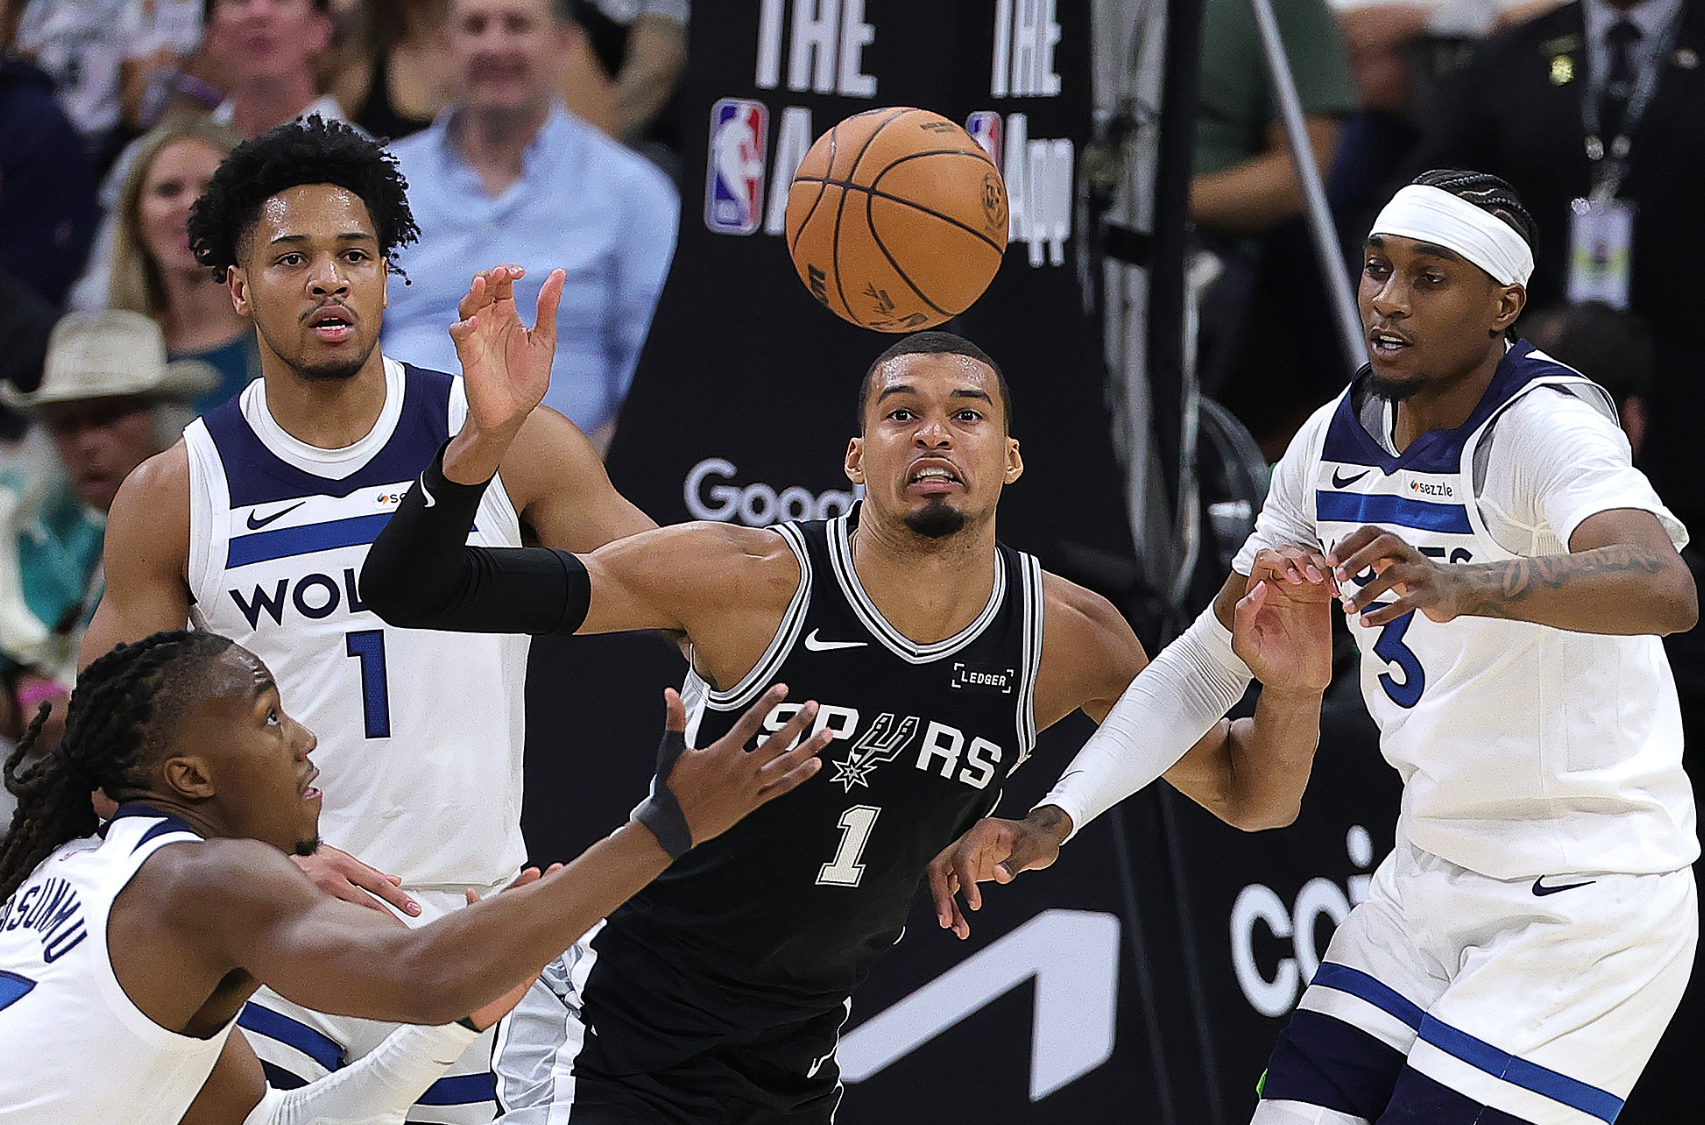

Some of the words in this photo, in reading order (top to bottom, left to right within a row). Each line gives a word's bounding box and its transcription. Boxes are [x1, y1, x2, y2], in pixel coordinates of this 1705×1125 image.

[1419, 481, 1453, 497] sezzle
[345, 629, 391, 739] 1
[960, 670, 1007, 687] LEDGER
[1361, 600, 1426, 709] 3
[814, 804, 883, 888] 1
